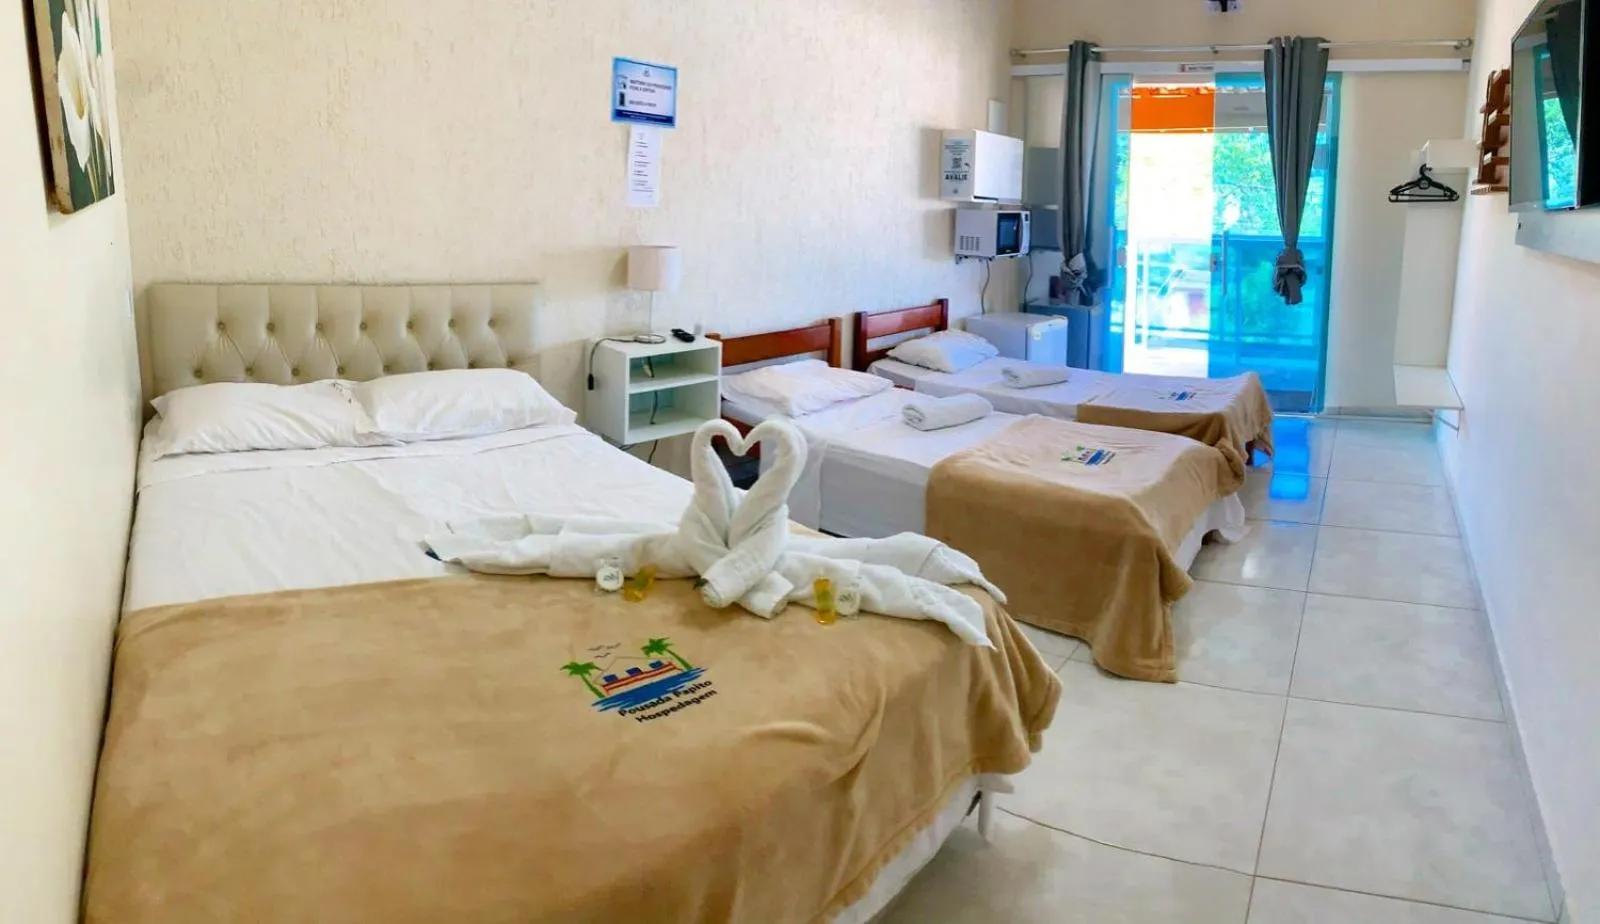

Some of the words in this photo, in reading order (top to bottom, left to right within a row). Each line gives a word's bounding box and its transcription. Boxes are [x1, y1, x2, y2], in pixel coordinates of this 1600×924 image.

[618, 695, 673, 717] Pousada
[672, 680, 713, 698] Papito
[635, 689, 718, 723] Hospedagem
